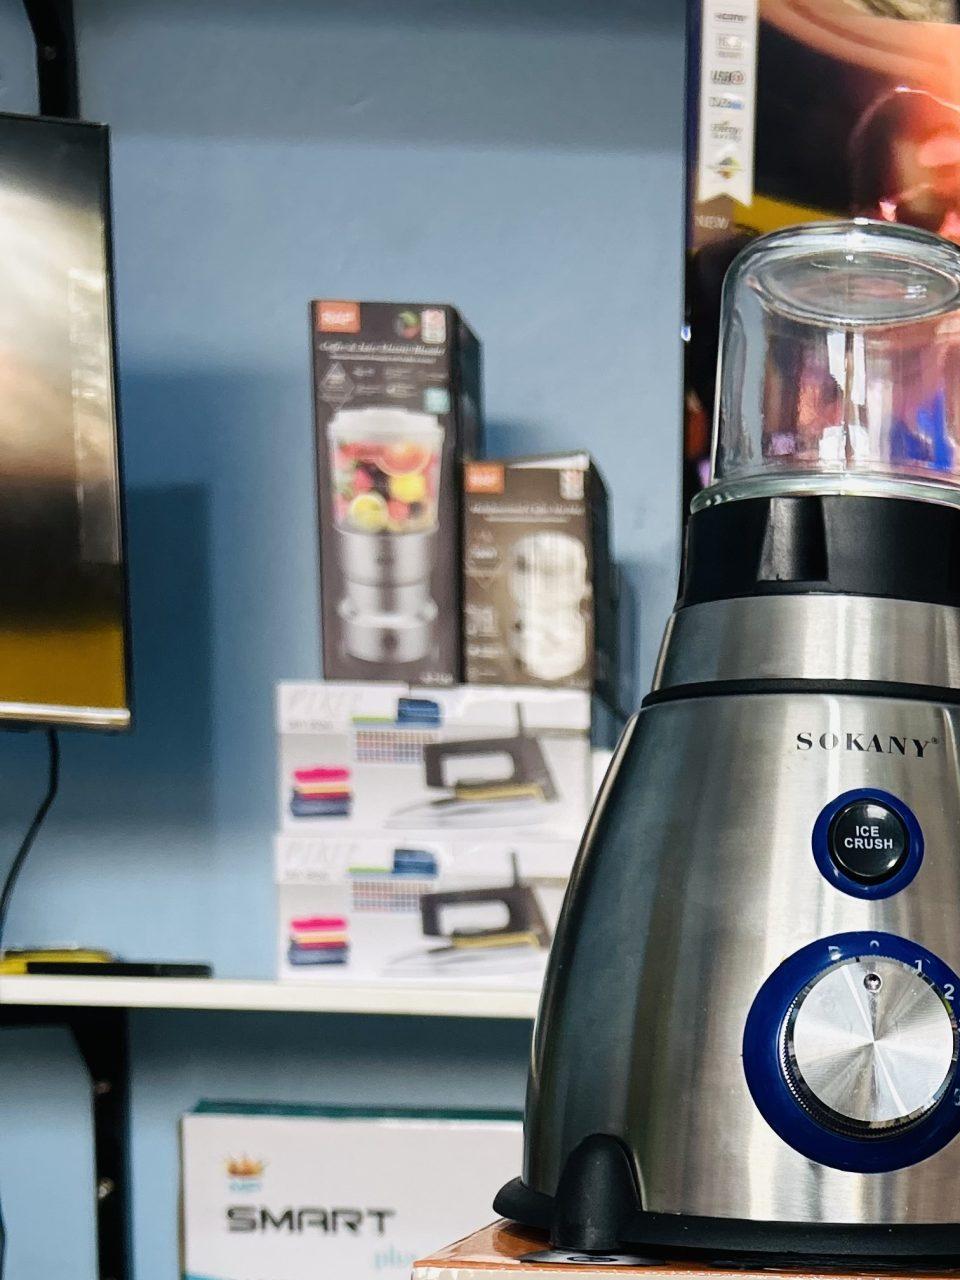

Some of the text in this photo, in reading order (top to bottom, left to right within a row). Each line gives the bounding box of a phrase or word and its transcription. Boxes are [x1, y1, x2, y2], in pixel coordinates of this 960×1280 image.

[855, 825, 880, 838] ICE
[844, 837, 894, 850] CRUSH
[943, 983, 956, 1001] 2
[227, 1204, 396, 1236] SMART
